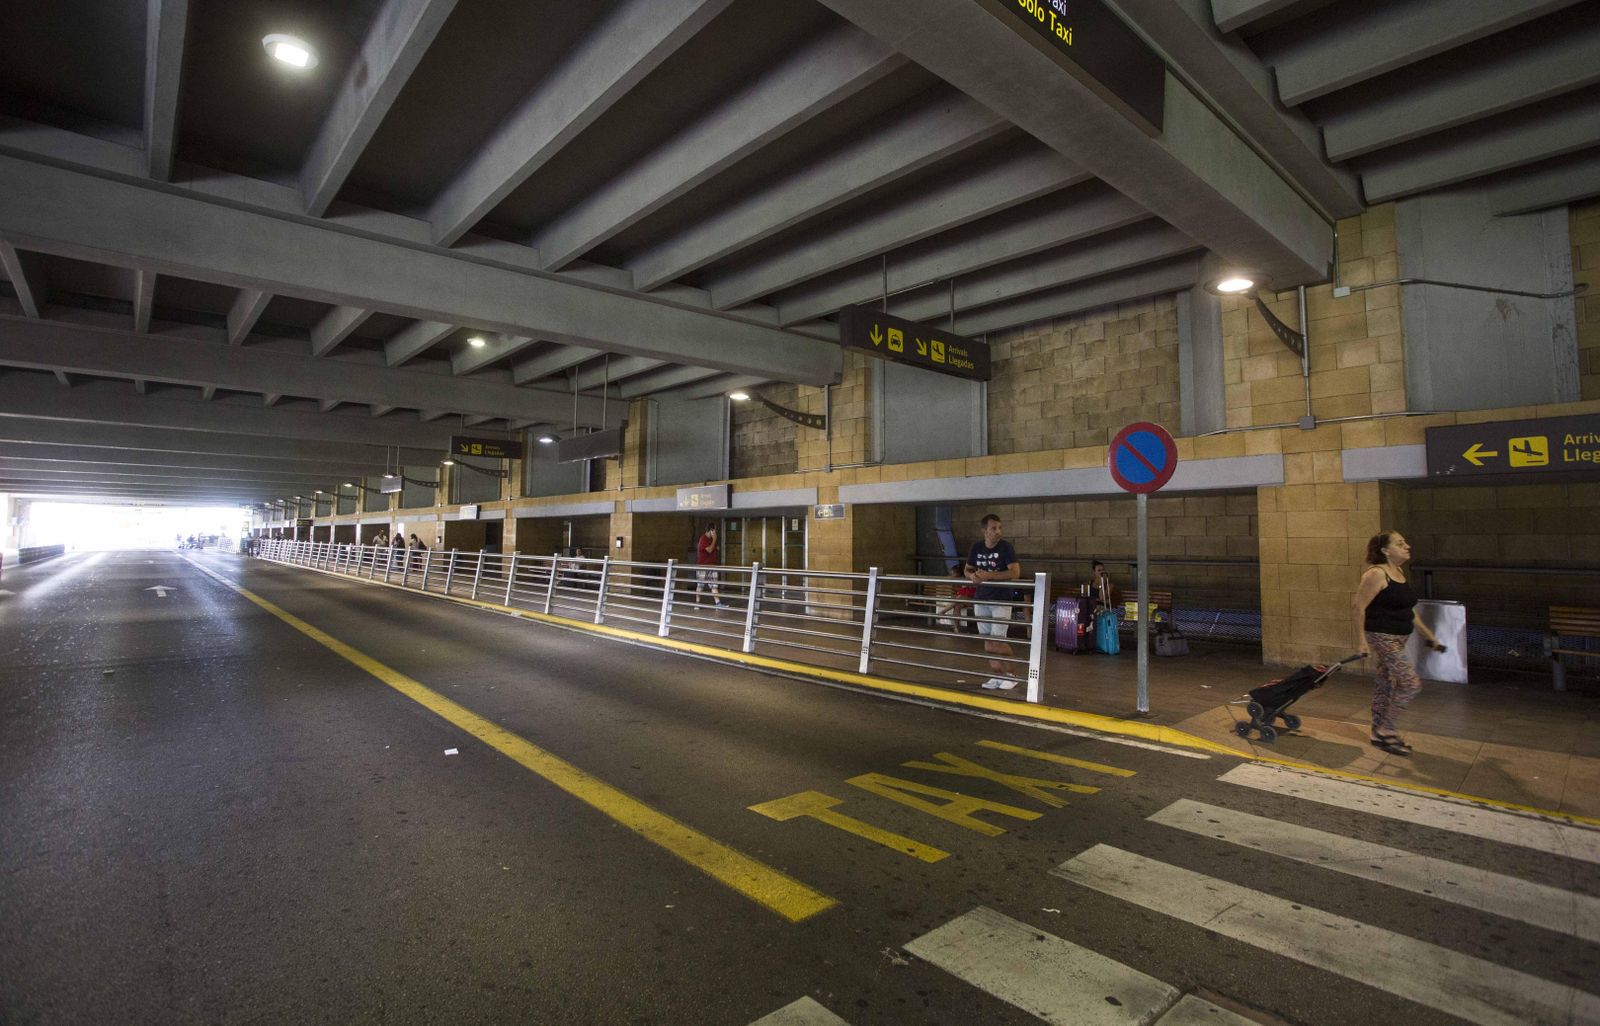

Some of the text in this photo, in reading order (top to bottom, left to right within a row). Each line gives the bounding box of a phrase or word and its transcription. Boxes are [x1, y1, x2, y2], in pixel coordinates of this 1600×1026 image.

[1047, 0, 1067, 16] axi
[1048, 10, 1073, 46] Taxi
[948, 355, 974, 369] Llegadas
[746, 739, 1138, 863] TAXI
